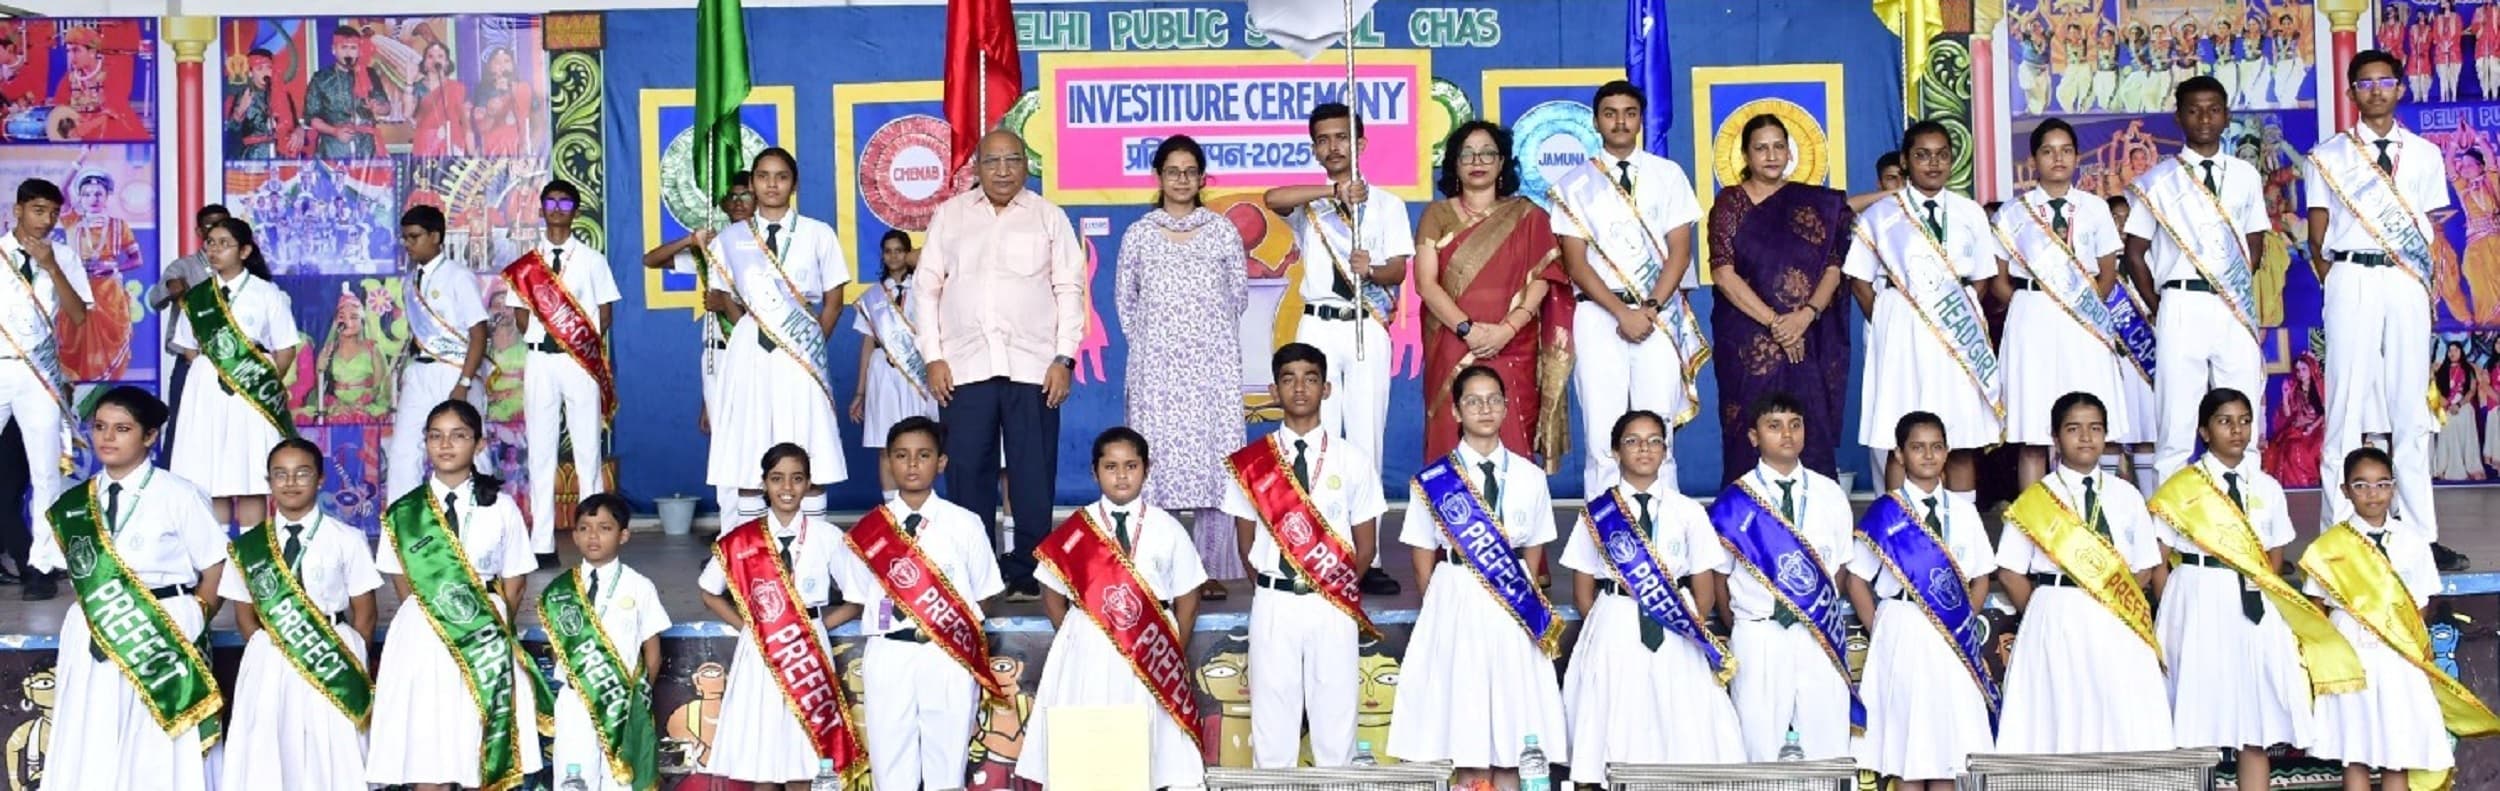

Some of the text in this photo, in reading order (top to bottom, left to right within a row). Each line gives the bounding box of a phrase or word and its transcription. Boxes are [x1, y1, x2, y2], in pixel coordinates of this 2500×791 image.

[1014, 11, 1091, 50] ELHI
[1109, 9, 1228, 50] PUBLIC
[1409, 8, 1500, 47] CHAS
[1068, 82, 1240, 124] INVESTITURE
[893, 165, 940, 181] CHENAB
[1538, 152, 1585, 167] JAMUNA
[1460, 520, 1534, 604] PREFECT
[86, 577, 191, 690] PREFECT
[268, 598, 349, 682] PREFECT
[765, 623, 843, 738] PREFECT
